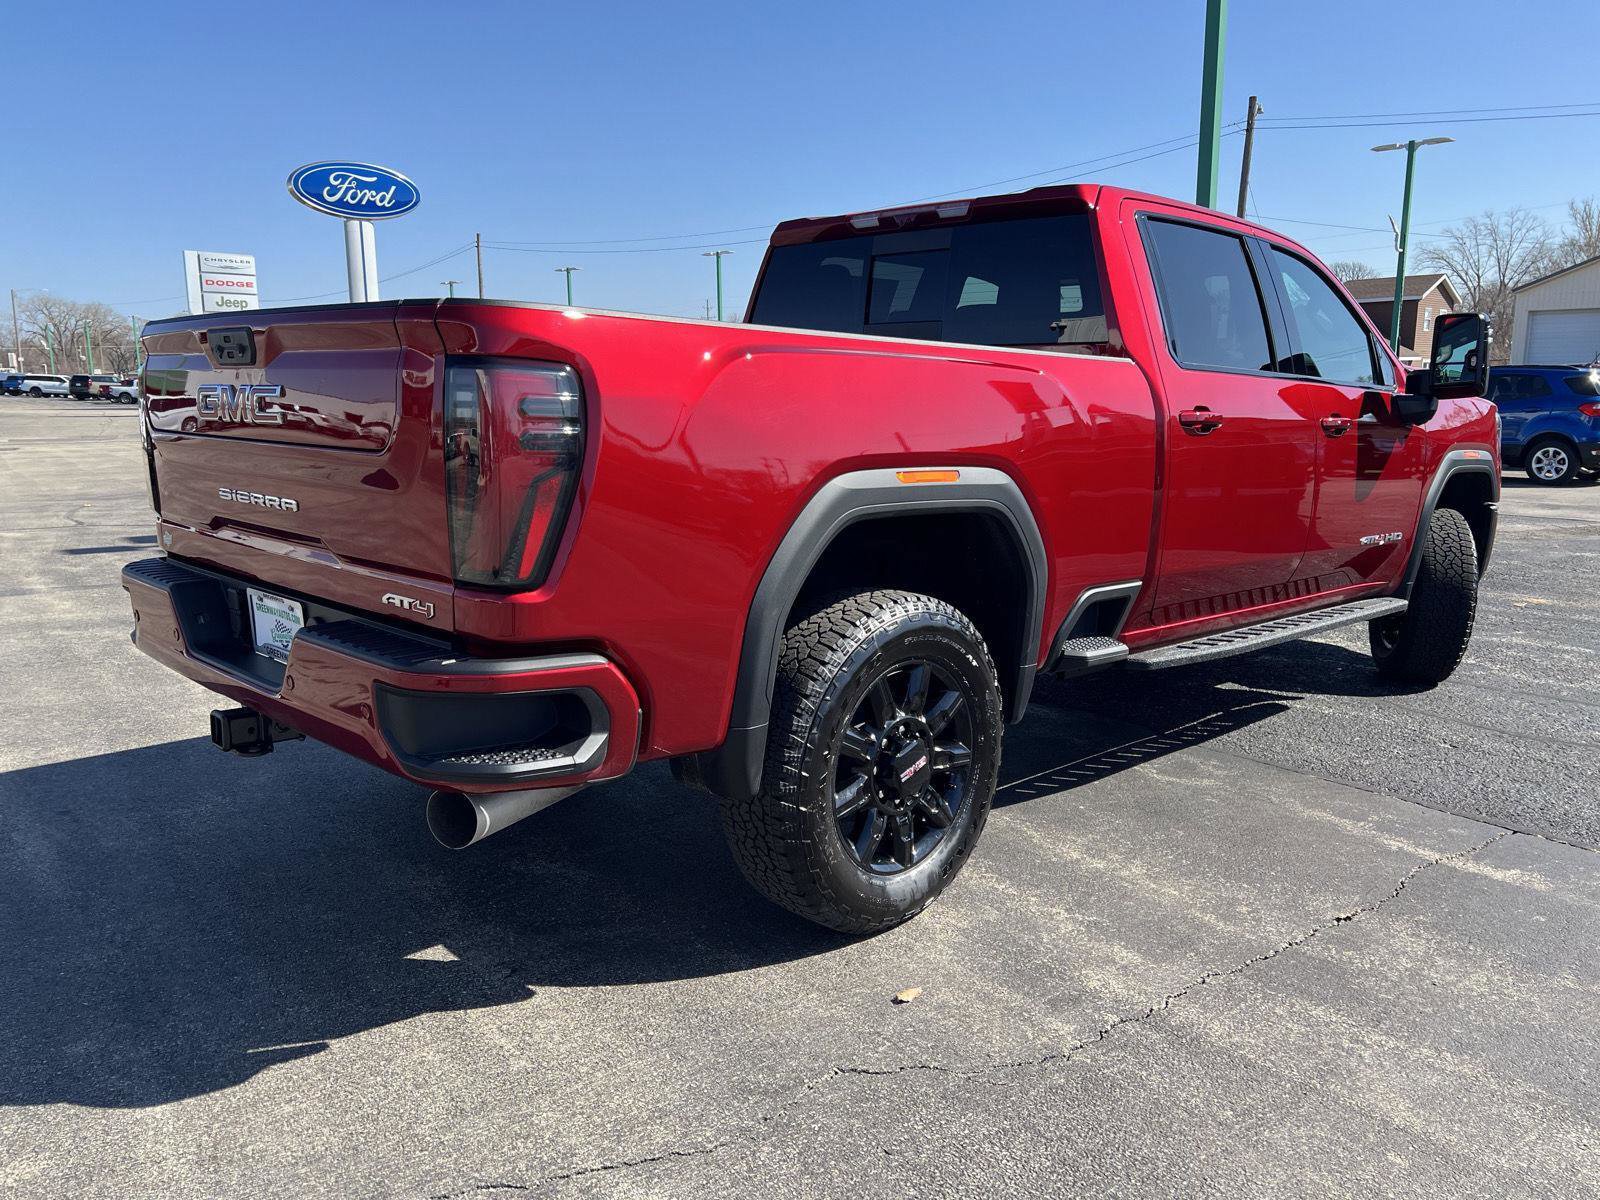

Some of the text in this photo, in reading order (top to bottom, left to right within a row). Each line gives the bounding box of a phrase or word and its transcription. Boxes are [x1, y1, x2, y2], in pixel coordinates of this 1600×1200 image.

[322, 171, 397, 208] Ford
[205, 279, 254, 288] DODGE
[215, 295, 249, 310] Jeep
[197, 384, 286, 425] GMC
[218, 487, 300, 512] SIERRA
[381, 593, 434, 619] AT4
